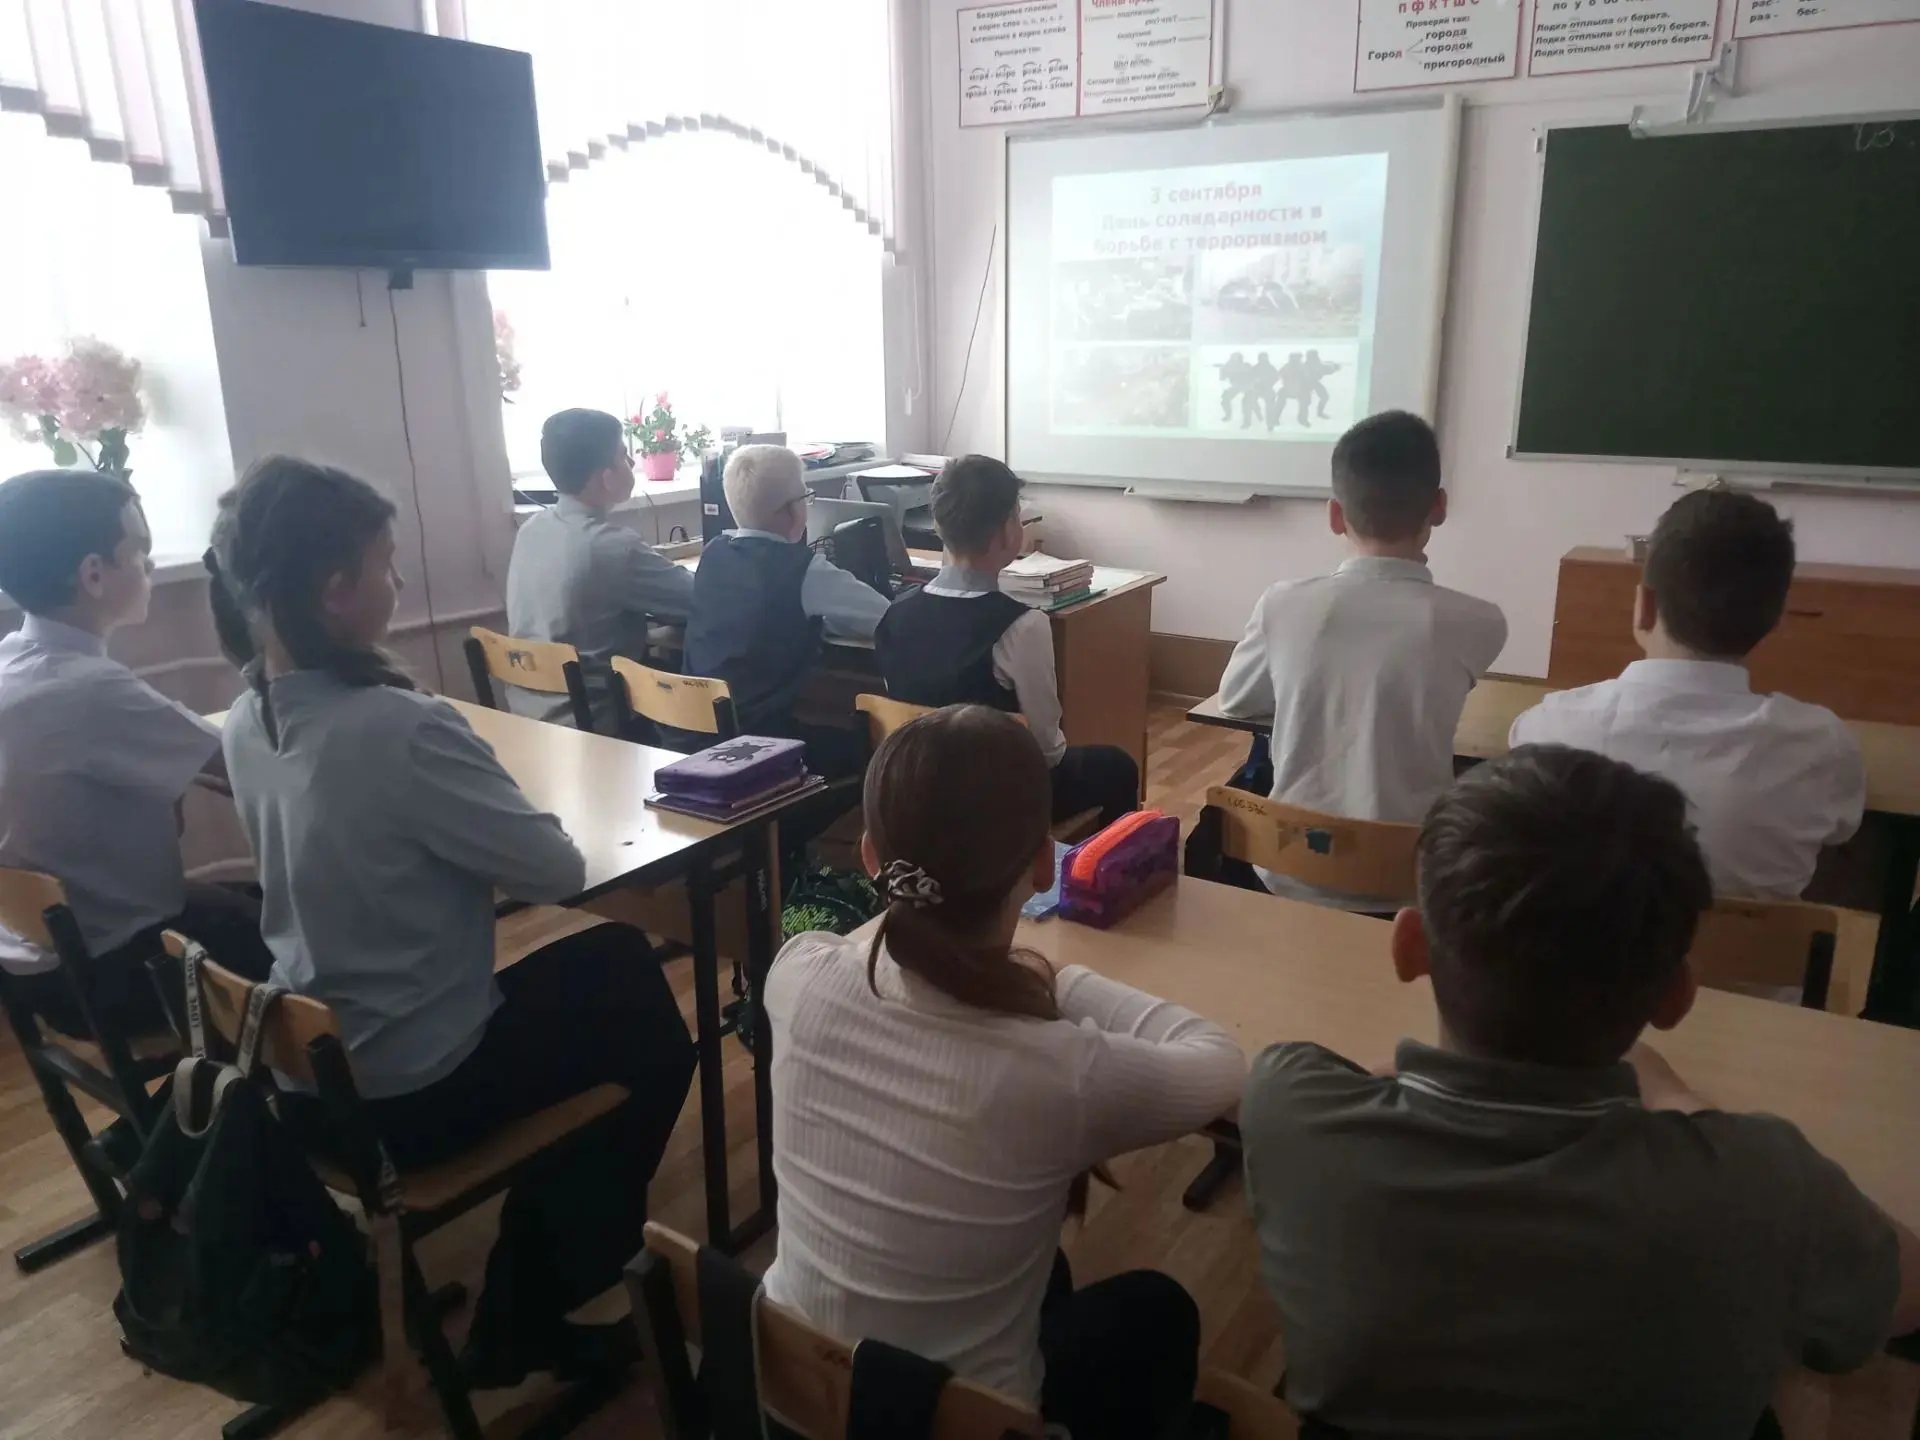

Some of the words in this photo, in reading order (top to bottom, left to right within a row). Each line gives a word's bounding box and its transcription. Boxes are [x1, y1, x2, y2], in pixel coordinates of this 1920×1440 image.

[1425, 28, 1467, 41] города
[1368, 49, 1403, 61] Город
[1424, 41, 1473, 54] городок
[1423, 52, 1505, 72] пригородный
[1150, 186, 1161, 205] 3
[1168, 180, 1263, 204] сентября
[1155, 205, 1304, 229] солидарности
[1310, 204, 1323, 220] в
[1169, 237, 1178, 251] с
[1186, 229, 1329, 252] терроризмом
